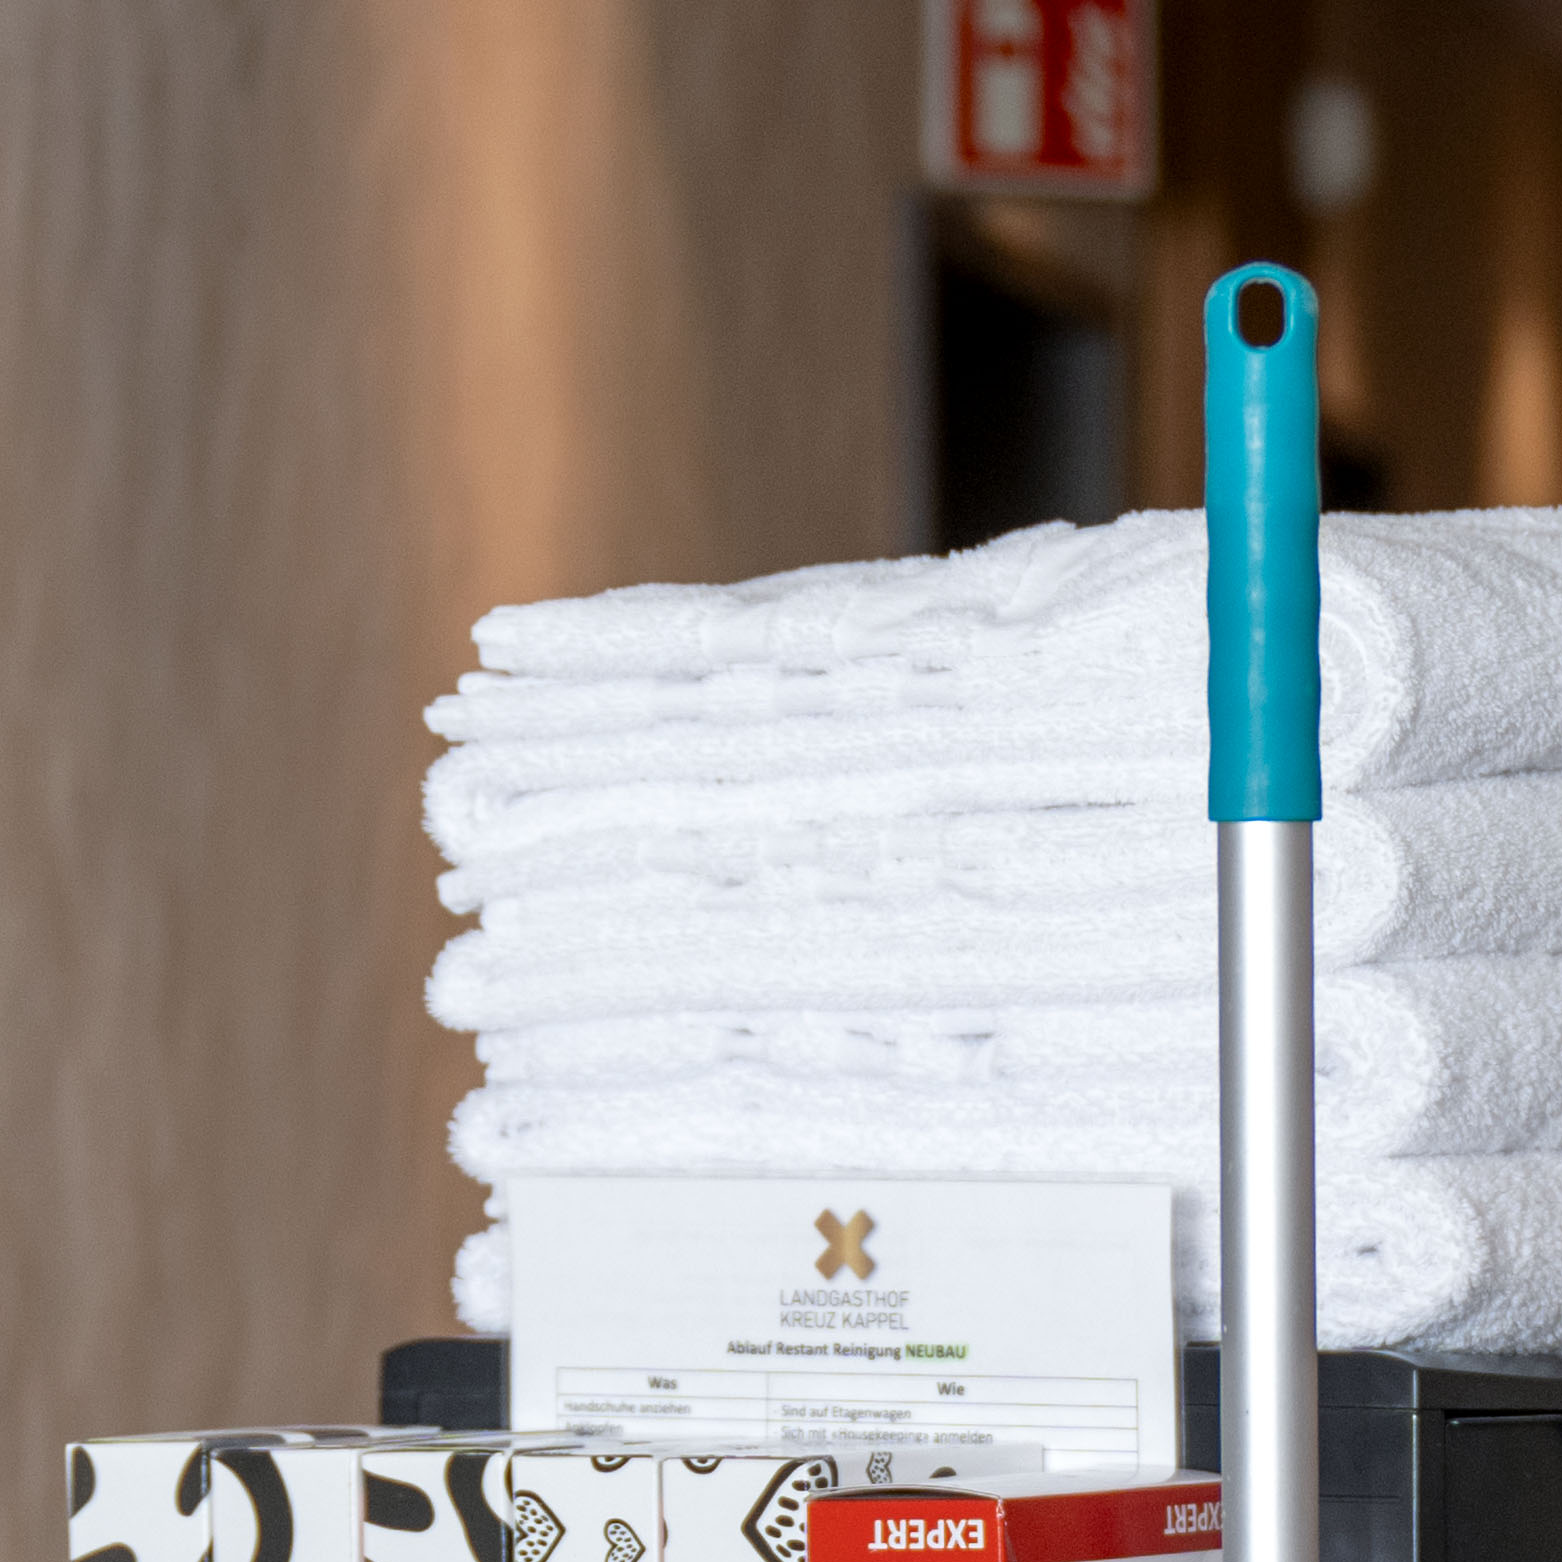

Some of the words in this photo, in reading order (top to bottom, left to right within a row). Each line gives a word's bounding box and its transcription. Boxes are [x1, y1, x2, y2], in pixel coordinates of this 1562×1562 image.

[779, 1290, 911, 1308] LANDGASTHOF
[780, 1311, 836, 1329] KREUZ
[842, 1312, 910, 1330] KAPPEL
[727, 1340, 772, 1355] Ablauf
[776, 1342, 828, 1356] Restant
[833, 1343, 902, 1360] Reinigung
[905, 1343, 968, 1359] NEUBAU
[647, 1376, 678, 1390] Was
[937, 1382, 965, 1396] Wie
[564, 1401, 636, 1414] Handschuhe
[781, 1405, 807, 1418] Sind
[809, 1405, 828, 1418] auf
[833, 1407, 912, 1422] Etagenwagen
[808, 1427, 827, 1440] mit
[933, 1430, 993, 1445] anmelden
[1164, 1502, 1221, 1535] XPERT
[868, 1519, 985, 1550] EXPERT
